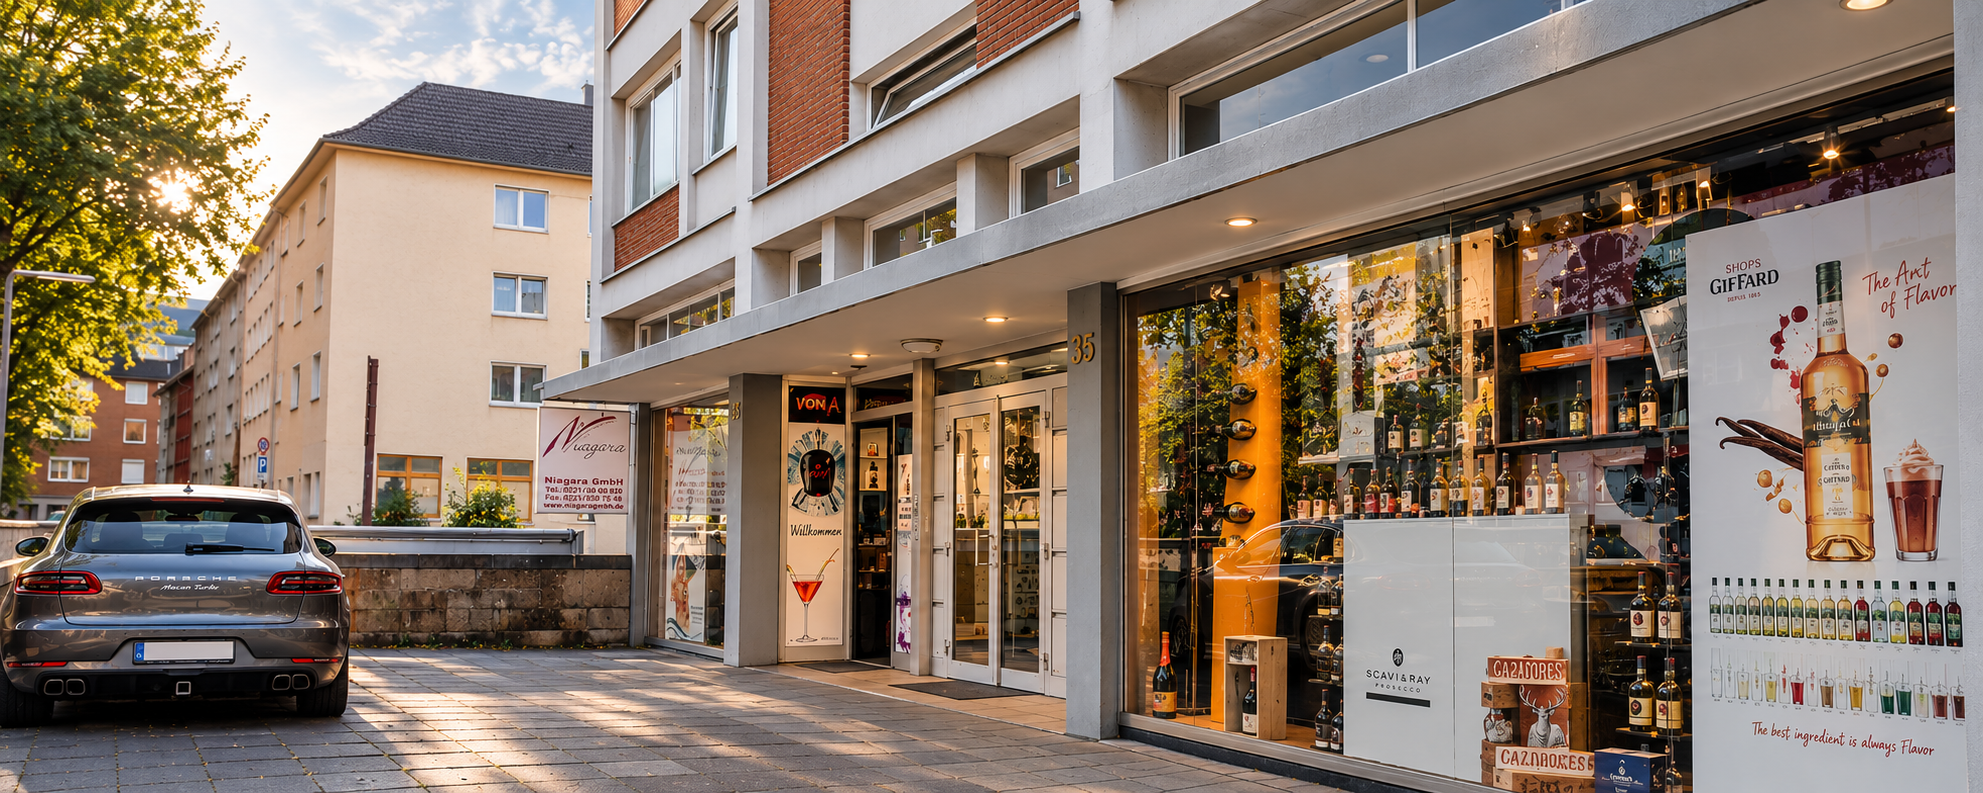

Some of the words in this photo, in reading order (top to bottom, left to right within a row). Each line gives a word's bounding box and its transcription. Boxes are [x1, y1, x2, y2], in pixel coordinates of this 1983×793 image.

[1725, 258, 1761, 274] SHOPS
[1709, 269, 1779, 295] GIFFARD
[1862, 271, 1891, 295] The
[1881, 291, 1897, 319] of
[1904, 283, 1957, 310] Flavor
[1071, 332, 1095, 364] 35
[796, 397, 826, 411] VON
[259, 458, 266, 472] P
[545, 476, 588, 486] Niagara
[592, 478, 623, 486] GmbH
[791, 524, 842, 536] Willkommen
[1375, 683, 1421, 693] PROSECCO
[1752, 721, 1768, 736] The
[1770, 723, 1791, 740] best
[1794, 729, 1845, 747] ingredient
[1849, 735, 1857, 747] is
[1861, 734, 1897, 757] always
[1901, 739, 1935, 756] Flavor
